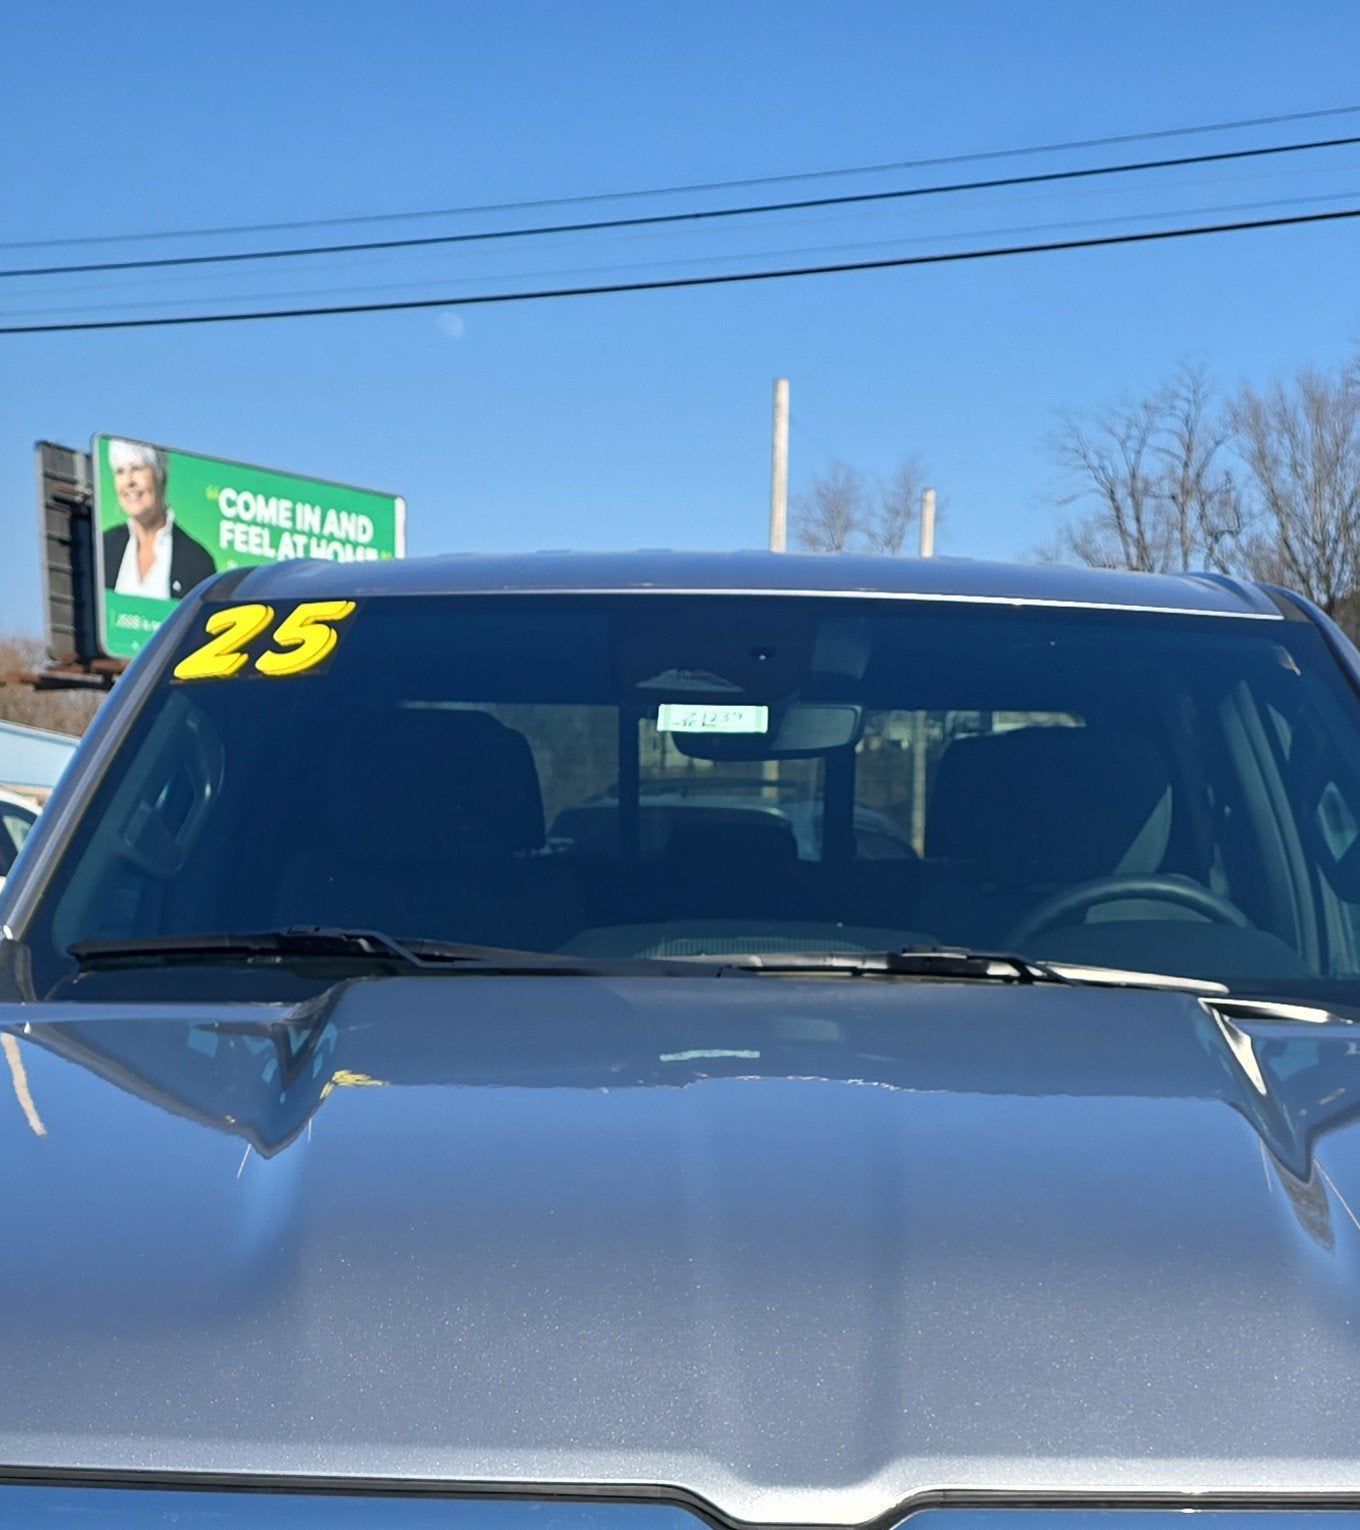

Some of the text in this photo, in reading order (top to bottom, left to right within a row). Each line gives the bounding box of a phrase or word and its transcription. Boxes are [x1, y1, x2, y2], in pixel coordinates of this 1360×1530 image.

[219, 519, 275, 559] FEEL
[277, 531, 308, 562] AT
[295, 501, 322, 535] IN
[323, 509, 374, 544] AND
[173, 601, 356, 680] 25
